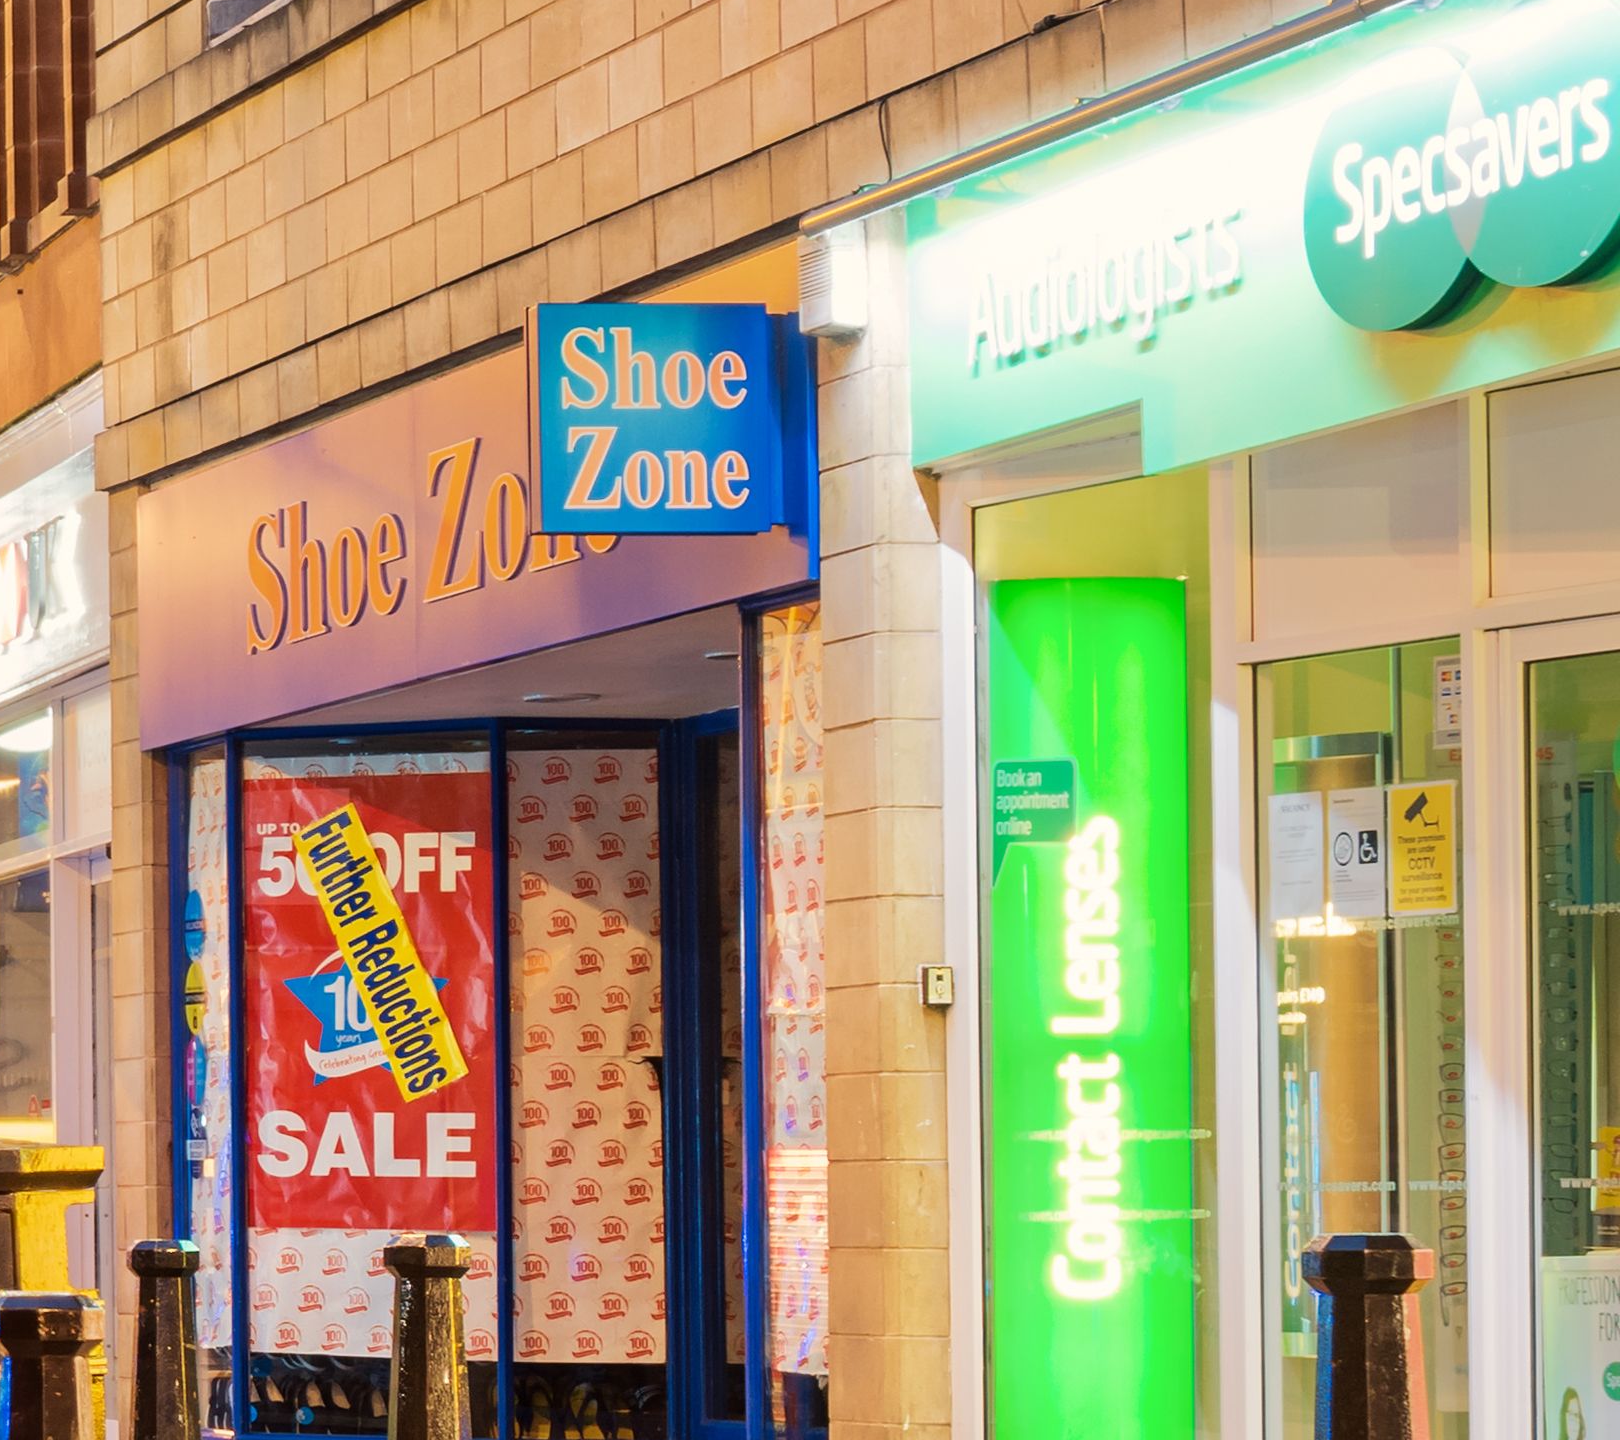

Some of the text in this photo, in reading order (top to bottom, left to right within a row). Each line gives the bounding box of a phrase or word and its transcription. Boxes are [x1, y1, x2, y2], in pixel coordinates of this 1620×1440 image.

[1331, 77, 1610, 260] Specsavers
[968, 207, 1242, 372] Audiologists
[560, 327, 748, 410] Shoe
[563, 426, 750, 510] Zone
[246, 501, 406, 655] Shoe
[996, 790, 1069, 814] appointment
[997, 768, 1042, 787] Book an
[257, 823, 300, 835] UP TO
[996, 816, 1032, 835] online
[1408, 856, 1435, 870] CCTV
[301, 810, 447, 1095] Further Reductions
[1049, 815, 1123, 1300] Contact Lenses
[257, 1110, 477, 1179] SALE
